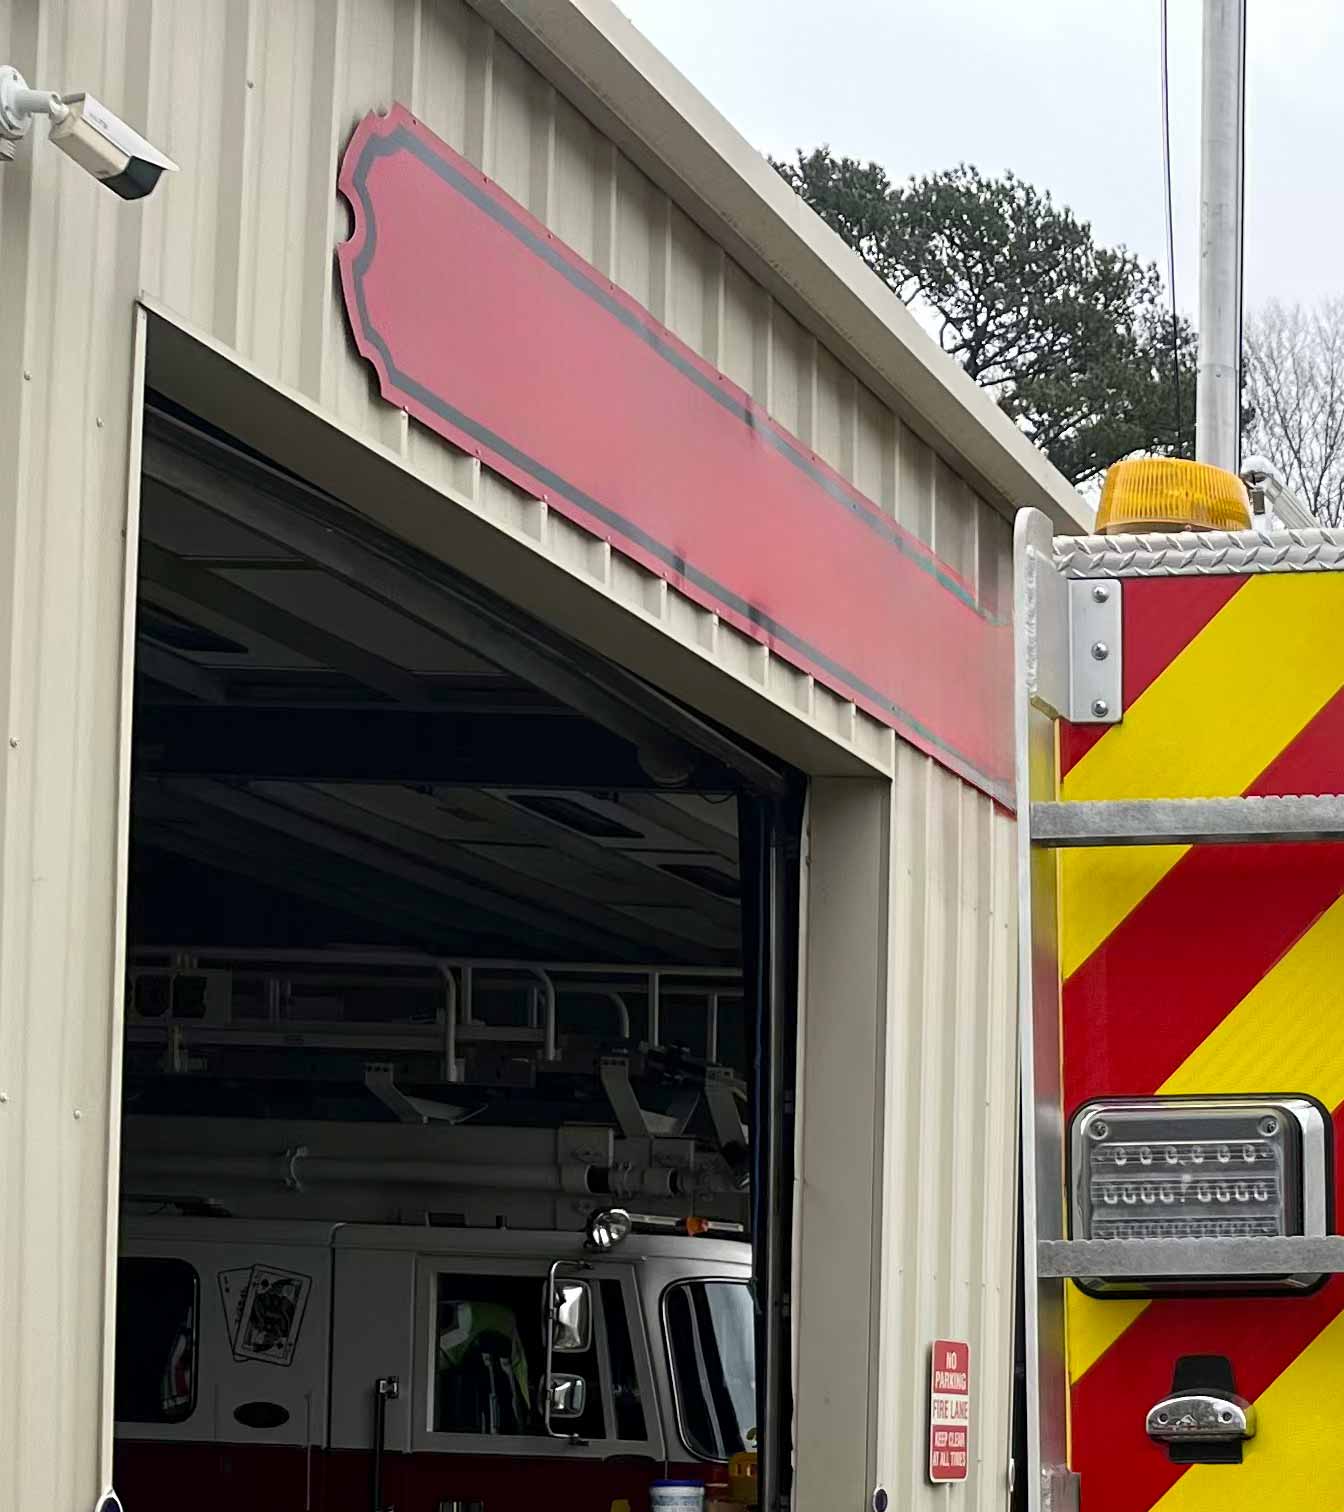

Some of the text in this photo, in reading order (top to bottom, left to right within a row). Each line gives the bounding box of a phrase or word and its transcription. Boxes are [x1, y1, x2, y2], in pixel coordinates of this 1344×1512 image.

[946, 1352, 956, 1370] NO
[935, 1371, 966, 1390] PARKING
[934, 1400, 968, 1419] FIRE LANE
[934, 1432, 948, 1447] KEEP
[933, 1451, 966, 1466] AT ALL TIMES
